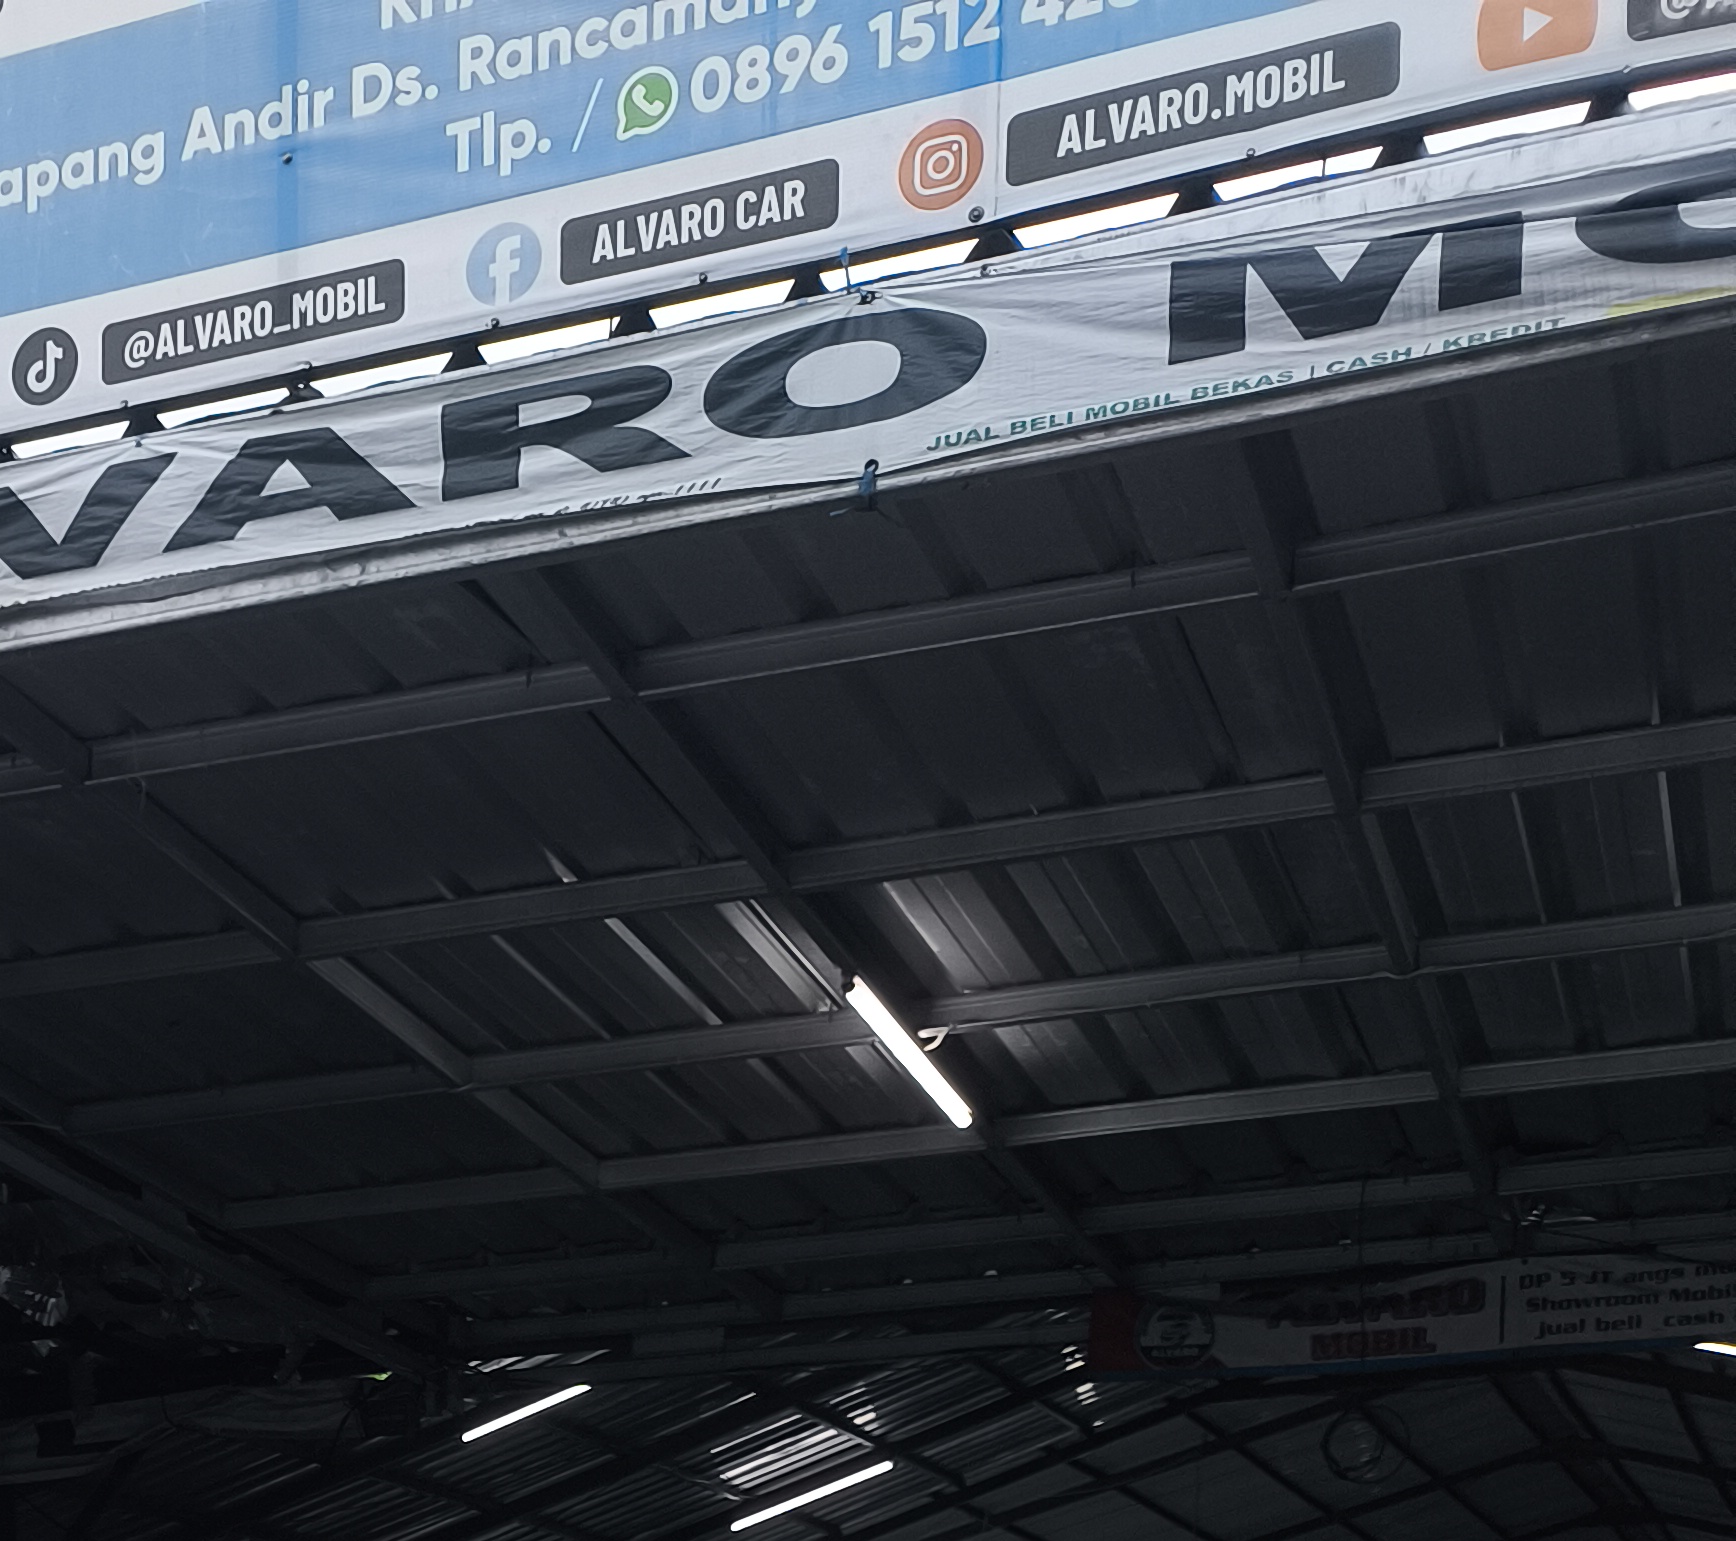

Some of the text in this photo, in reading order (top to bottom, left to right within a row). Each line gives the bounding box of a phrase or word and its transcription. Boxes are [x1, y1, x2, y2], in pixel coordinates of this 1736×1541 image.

[181, 79, 336, 161] Andir
[351, 62, 439, 119] Ds.
[459, 0, 816, 92] Rancama
[445, 110, 552, 177] Tlp.
[690, 23, 849, 114] 0896
[868, 0, 1000, 70] 1512
[1056, 49, 1346, 159] ALVARO.MOBIL
[591, 179, 806, 264] ALVARO CAR
[124, 275, 386, 369] @ALVARO_MOBIL
[925, 424, 1000, 453] JUAL
[1008, 410, 1075, 437] BELI
[1084, 391, 1181, 421] MOBIL
[1189, 369, 1295, 402] BEKAS
[1325, 346, 1414, 377] CASH
[1441, 316, 1567, 352] KREDIT
[1525, 1291, 1661, 1313] Showroom
[1533, 1317, 1586, 1340] jual
